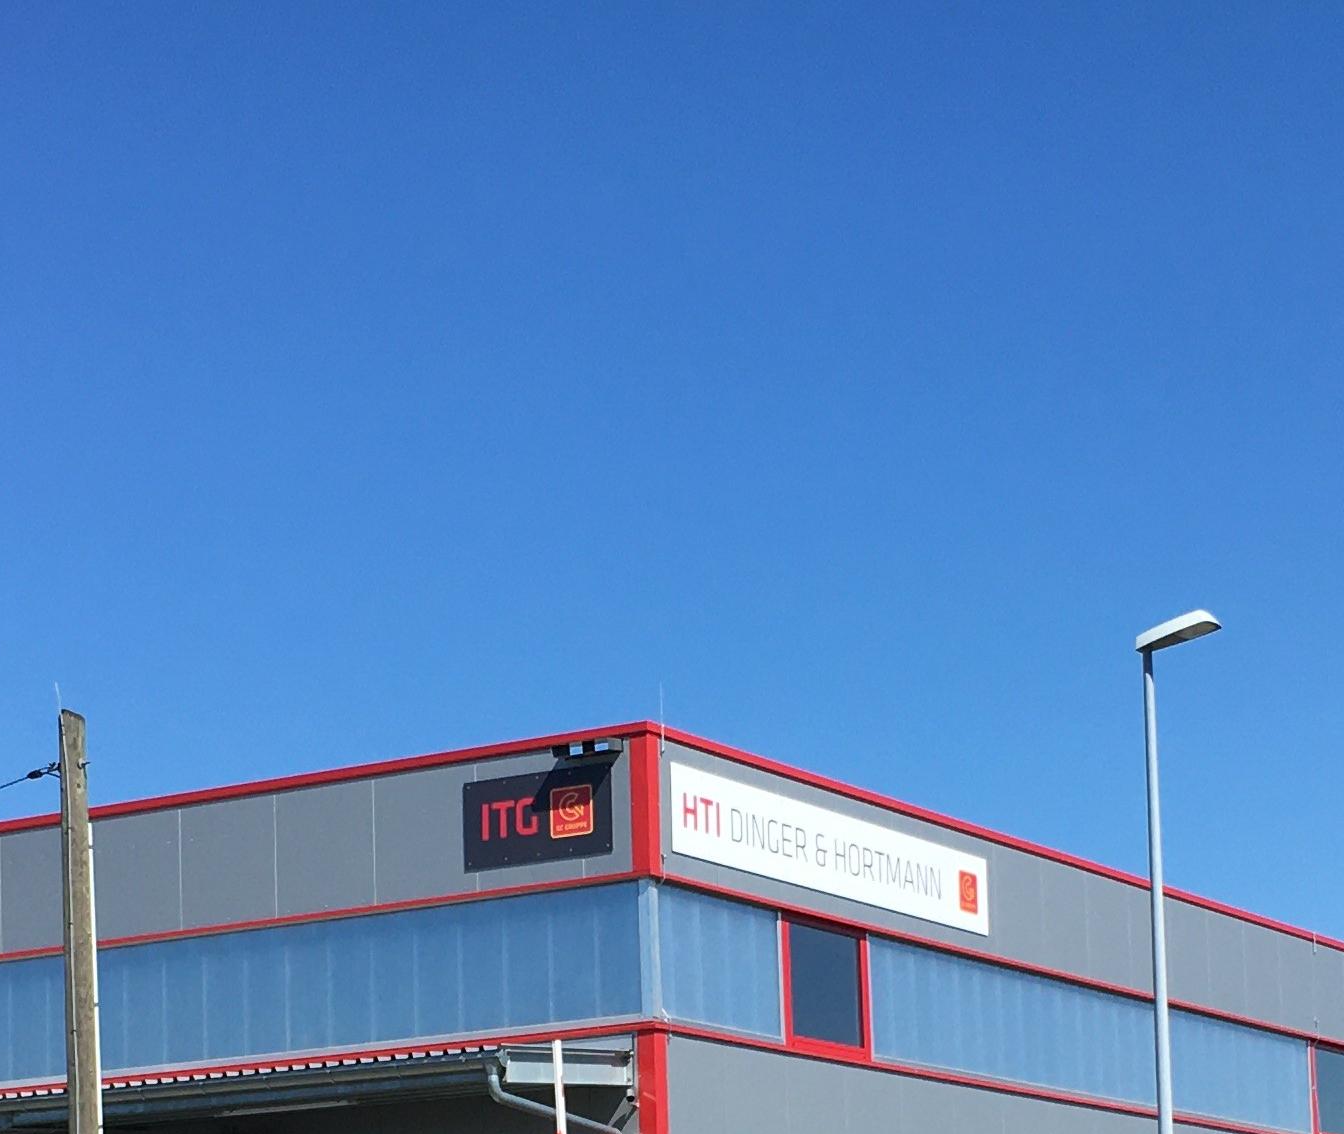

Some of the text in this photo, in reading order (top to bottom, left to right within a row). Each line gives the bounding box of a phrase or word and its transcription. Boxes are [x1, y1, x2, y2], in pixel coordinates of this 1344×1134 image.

[481, 797, 538, 841] ITG
[683, 792, 941, 900] HTI DINGER & HORTMANN
